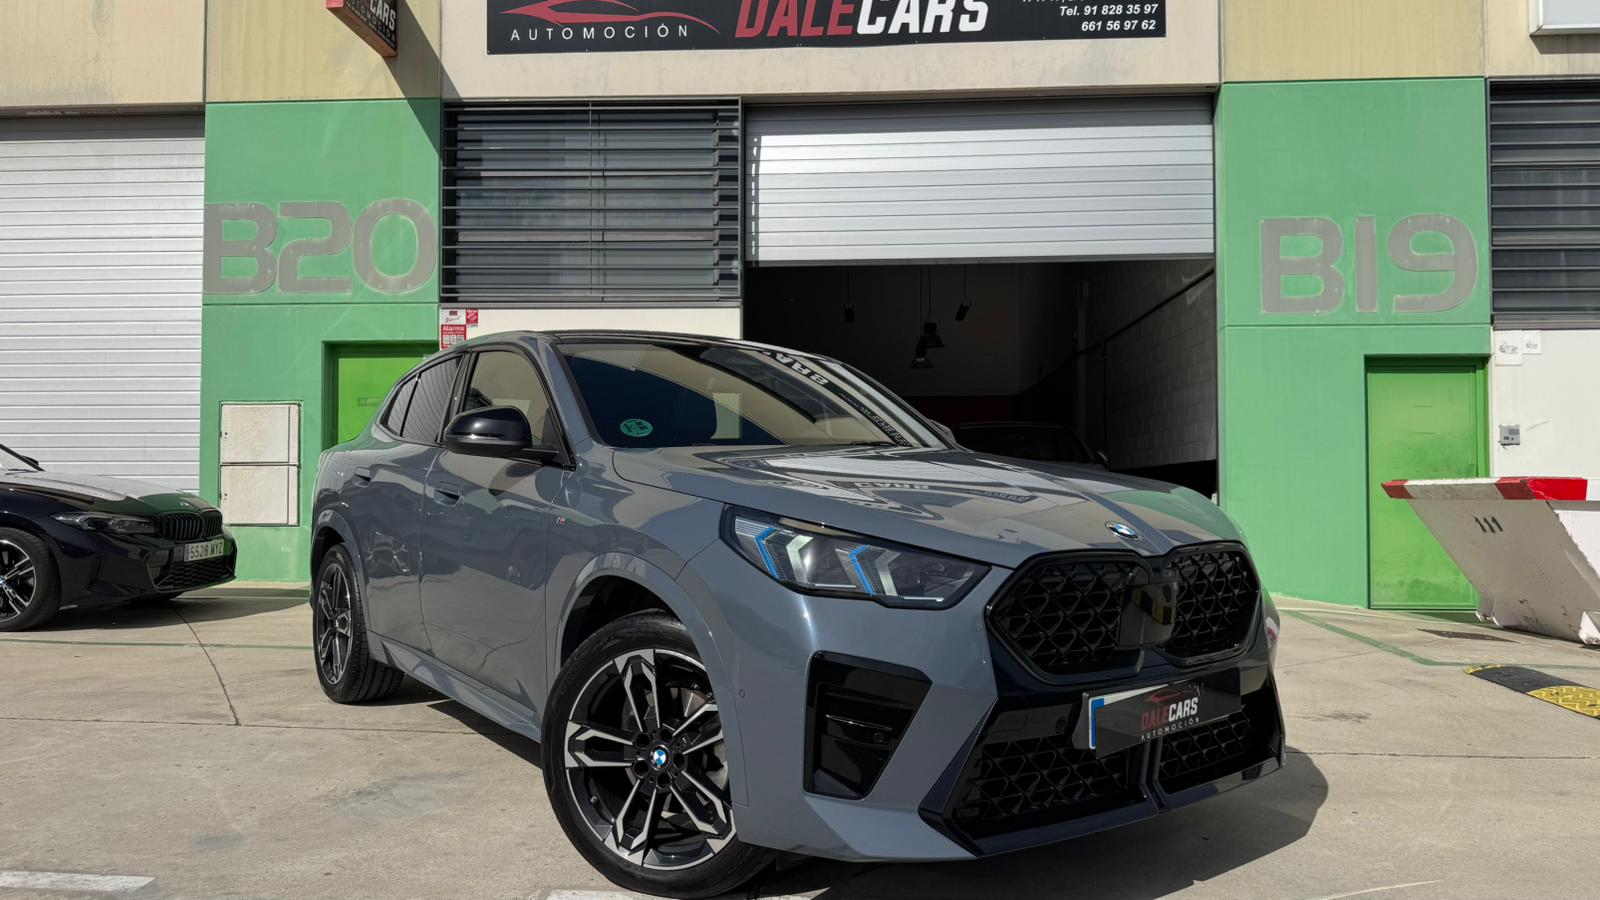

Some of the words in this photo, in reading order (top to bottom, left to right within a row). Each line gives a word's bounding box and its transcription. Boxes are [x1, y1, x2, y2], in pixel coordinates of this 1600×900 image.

[734, 0, 989, 38] DALECARS
[1060, 6, 1080, 16] Tel.
[1084, 5, 1097, 15] 91
[1101, 5, 1123, 15] 828
[1126, 4, 1141, 15] 35
[1144, 4, 1159, 14] 97
[510, 23, 688, 41] AUTOMOCIÓN
[1081, 21, 1102, 32] 661
[1106, 20, 1121, 31] 56
[1123, 20, 1138, 30] 97
[1141, 19, 1156, 30] 62
[202, 198, 437, 295] B20
[1261, 214, 1478, 314] B19
[190, 544, 208, 560] 5528
[1141, 697, 1199, 732] DALECARS
